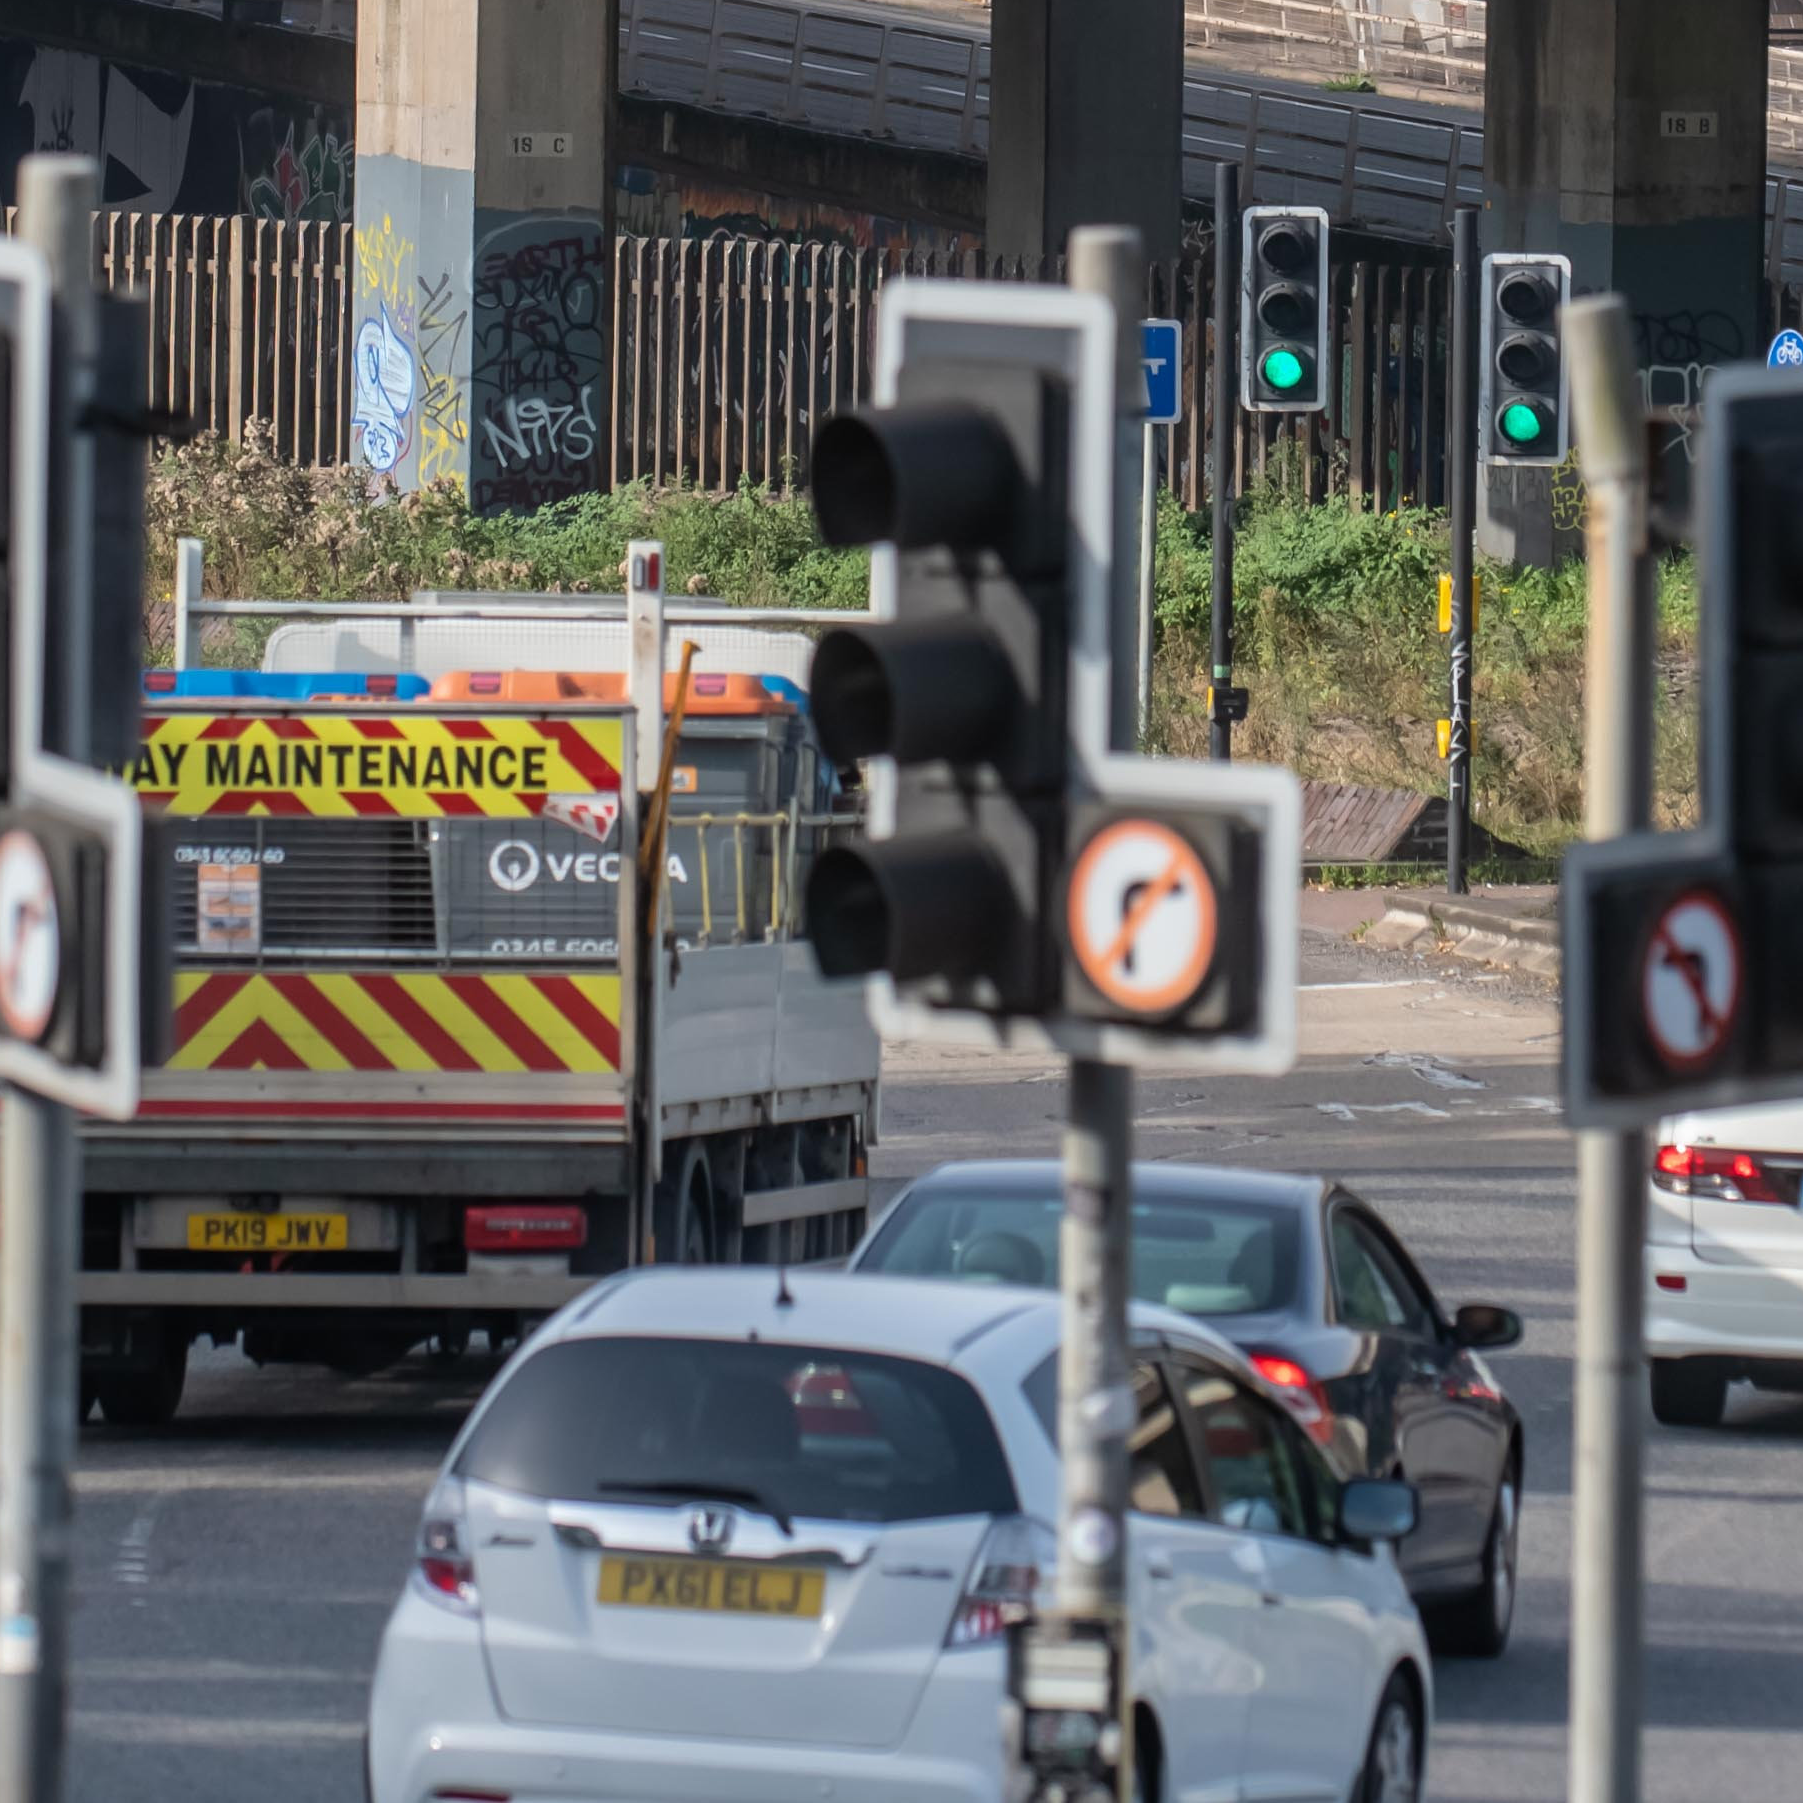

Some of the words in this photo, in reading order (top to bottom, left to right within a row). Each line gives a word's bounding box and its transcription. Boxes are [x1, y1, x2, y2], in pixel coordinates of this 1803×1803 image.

[1667, 117, 1686, 134] 18
[553, 137, 565, 154] C
[128, 743, 190, 785] AY
[205, 744, 548, 789] MAINTENANCE
[205, 1219, 267, 1245] PK19
[276, 1219, 331, 1245] JWV
[622, 1559, 710, 1607] PX61
[722, 1566, 802, 1614] ELJ
